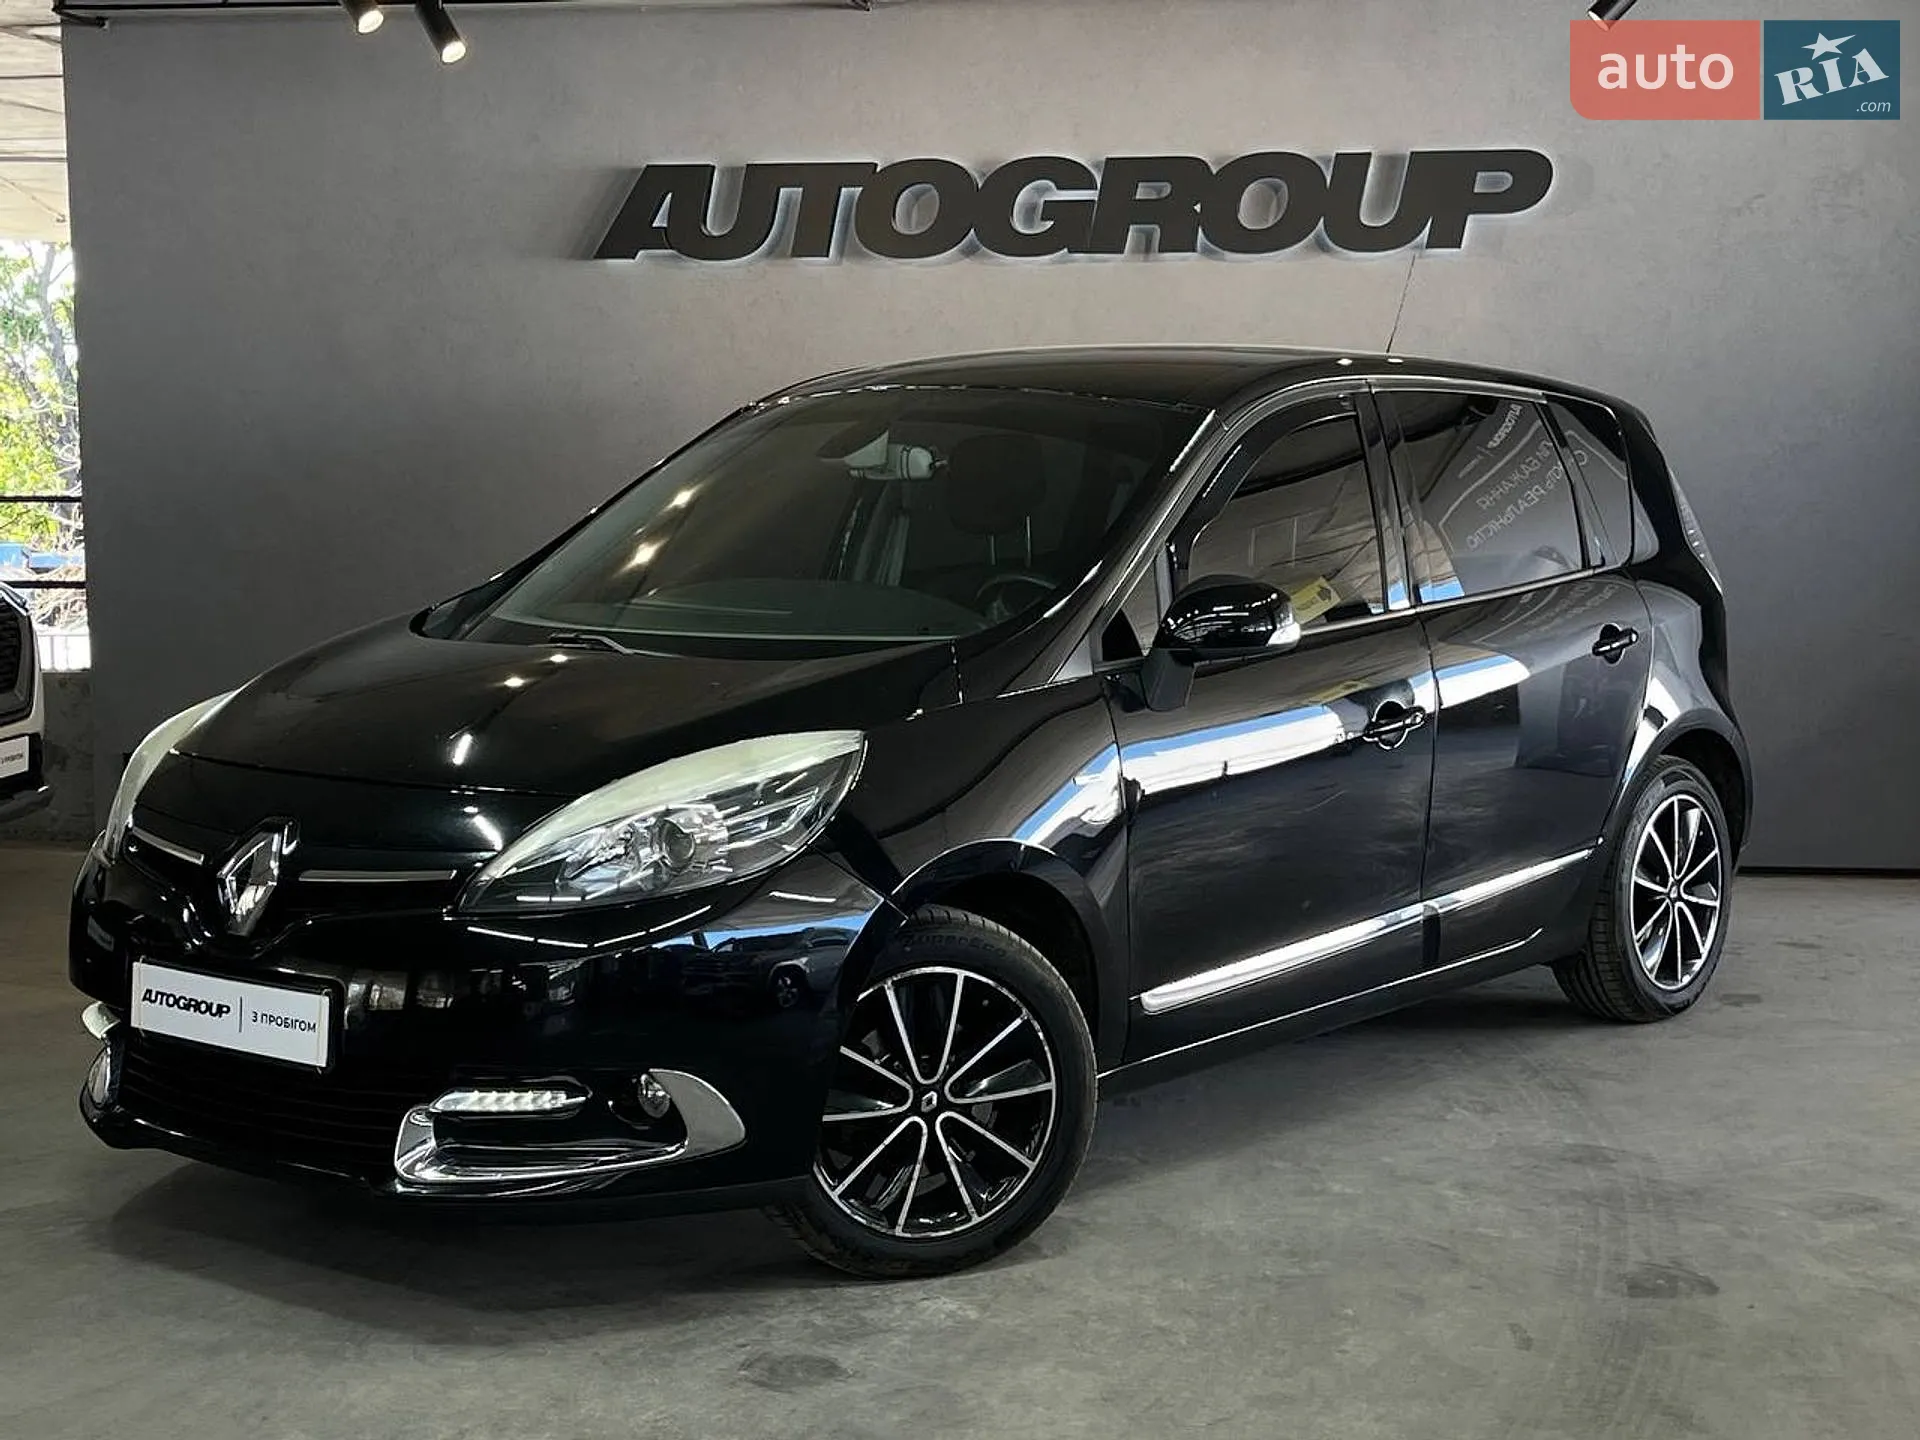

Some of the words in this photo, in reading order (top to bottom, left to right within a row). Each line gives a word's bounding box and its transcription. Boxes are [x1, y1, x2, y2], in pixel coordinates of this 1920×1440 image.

[592, 149, 1554, 261] AUTOGROUP
[142, 988, 231, 1019] AUTOGROUP
[260, 1012, 317, 1033] ПРОБІГОМ
